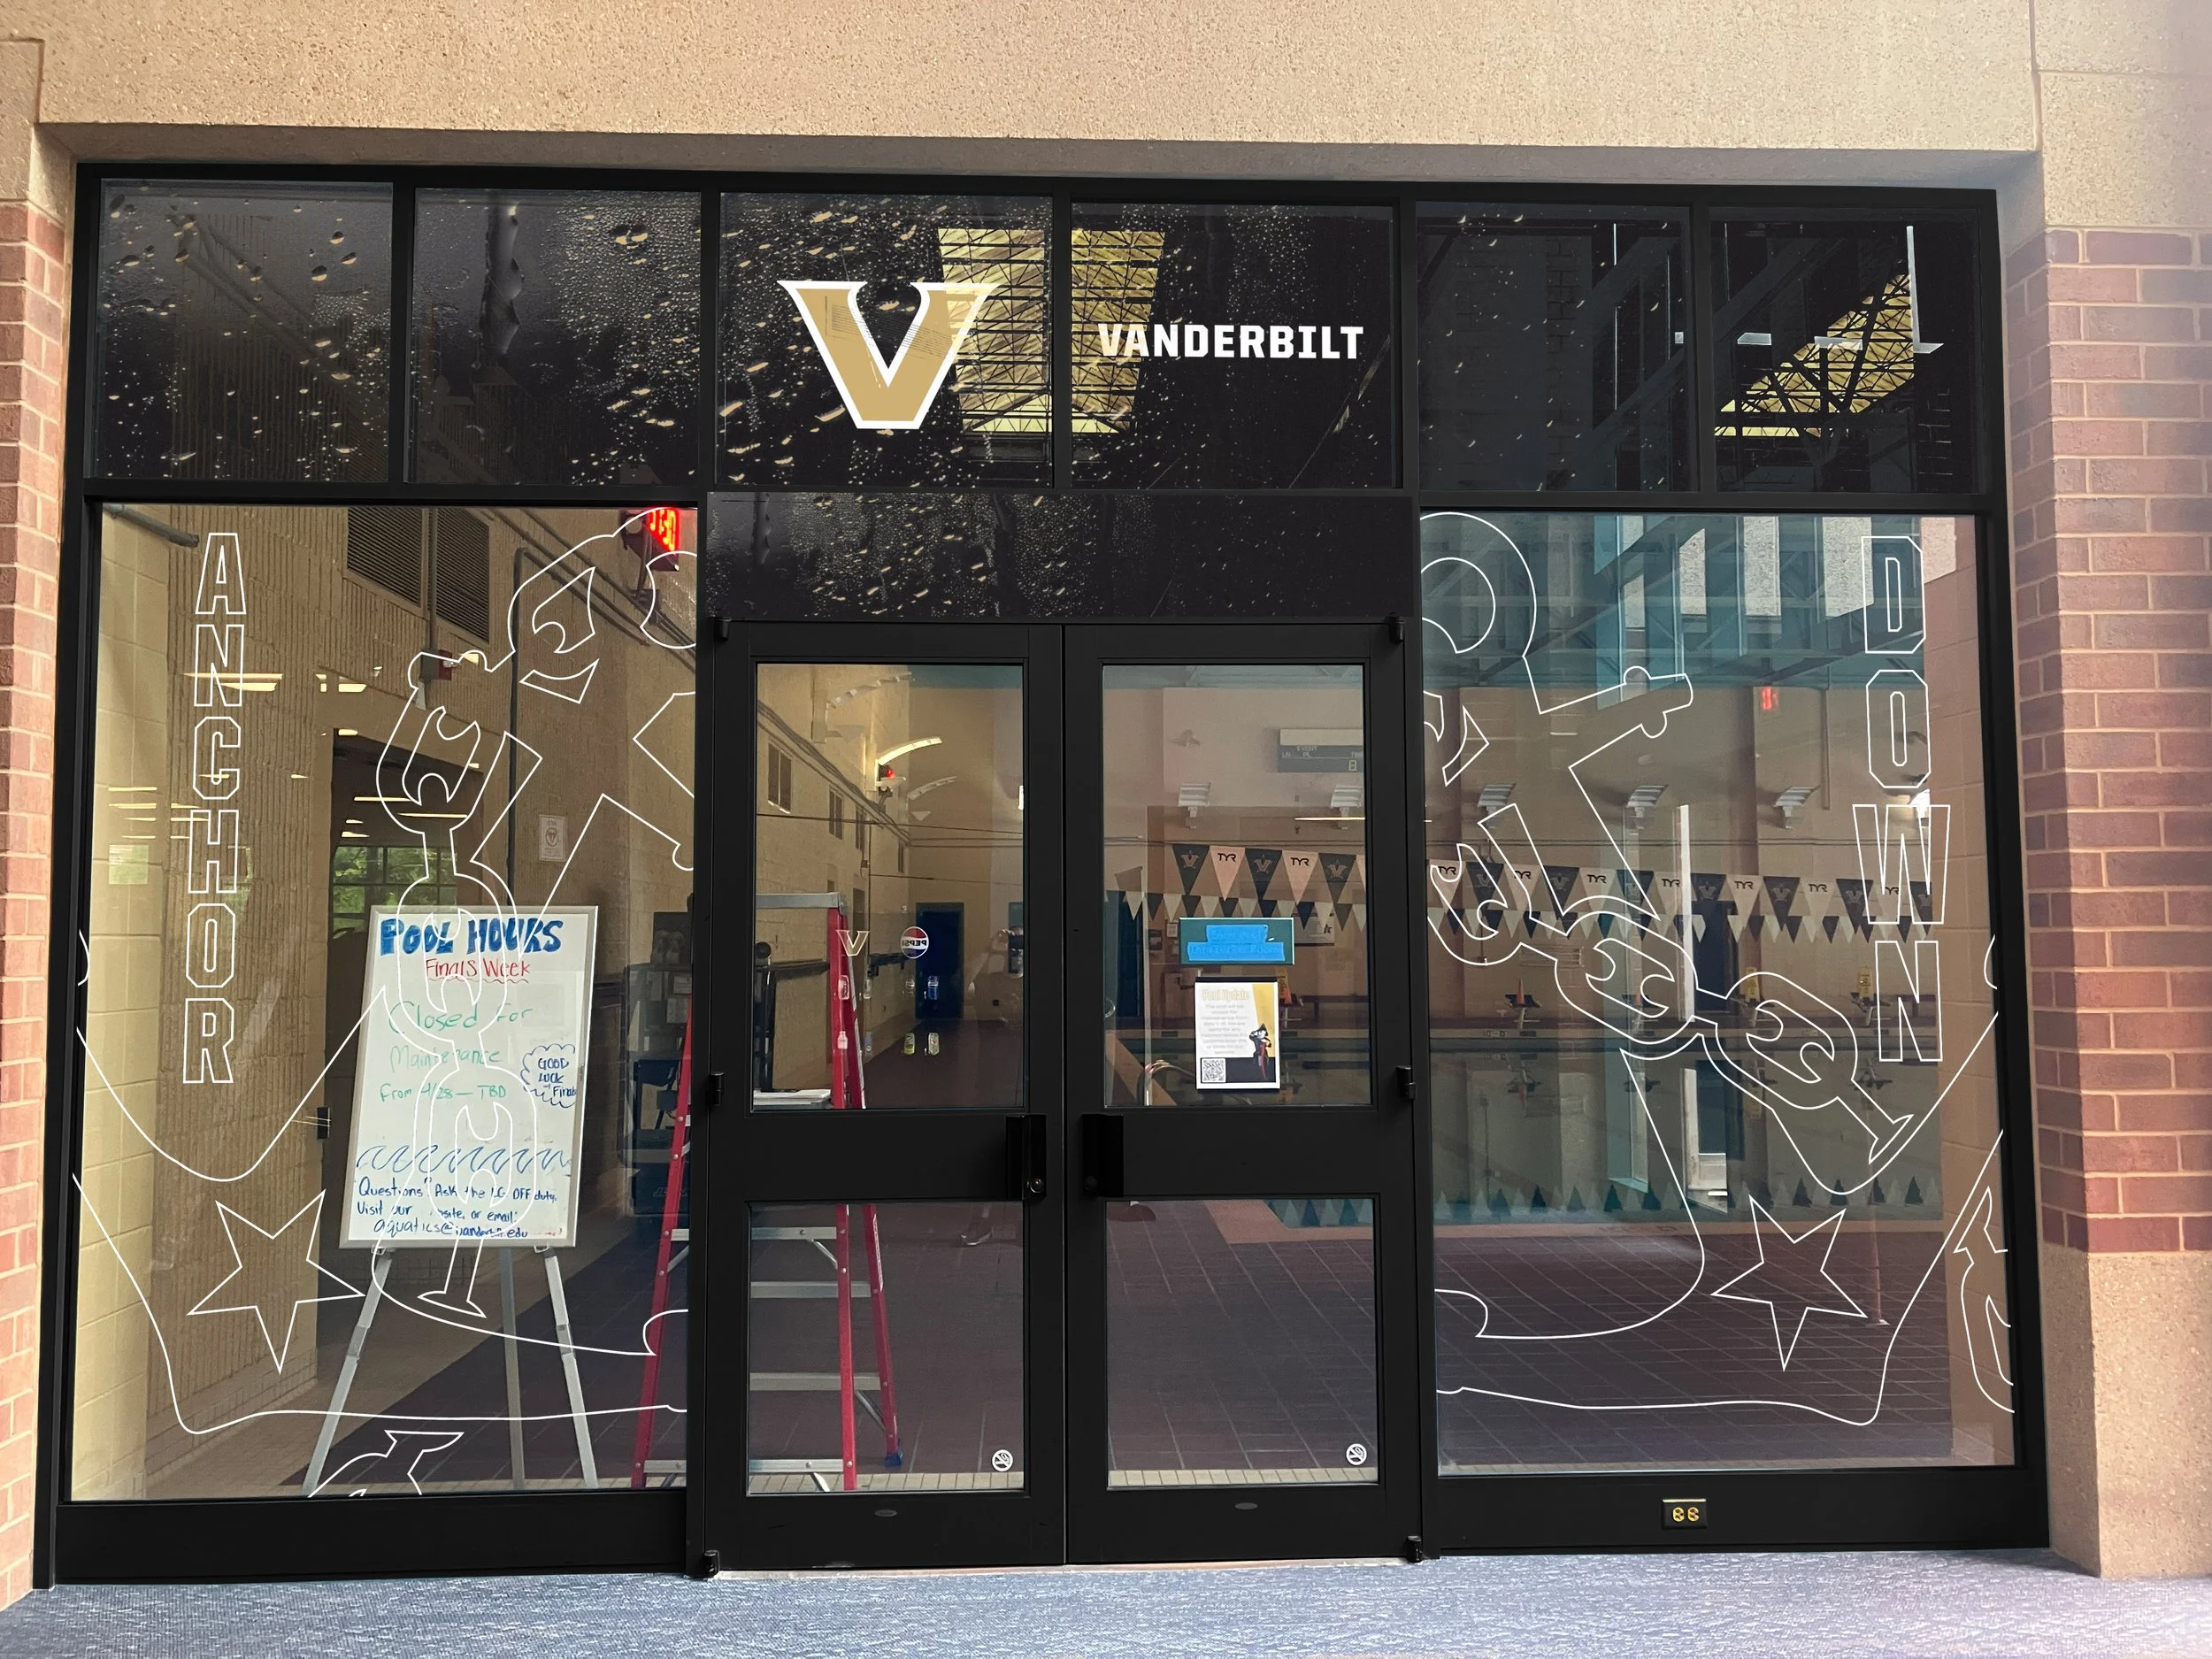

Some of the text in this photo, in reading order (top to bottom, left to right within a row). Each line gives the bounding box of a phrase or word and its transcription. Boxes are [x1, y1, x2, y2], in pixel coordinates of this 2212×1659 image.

[1098, 322, 1363, 360] VANDERBILT
[778, 280, 1001, 430] V
[1852, 535, 1951, 1063] DOWN
[182, 532, 247, 1084] ANCHOR
[1217, 852, 1237, 863] TYR
[1290, 856, 1310, 866] TYR
[1438, 865, 1457, 876] TYR
[1586, 873, 1607, 884] TYR
[1661, 878, 1680, 887] TYR
[1733, 880, 1754, 890] TYR
[1808, 883, 1828, 893] TYR
[380, 917, 565, 956] POOL HOURS
[482, 957, 531, 978] Week
[388, 1000, 479, 1033] Closed
[537, 1057, 570, 1071] GOOD
[538, 1071, 565, 1084] LUCK
[476, 1084, 506, 1099] TBD
[434, 1182, 458, 1198] Ask
[512, 1187, 532, 1201] OFF
[357, 1199, 383, 1216] Visit
[470, 1210, 480, 1220] or
